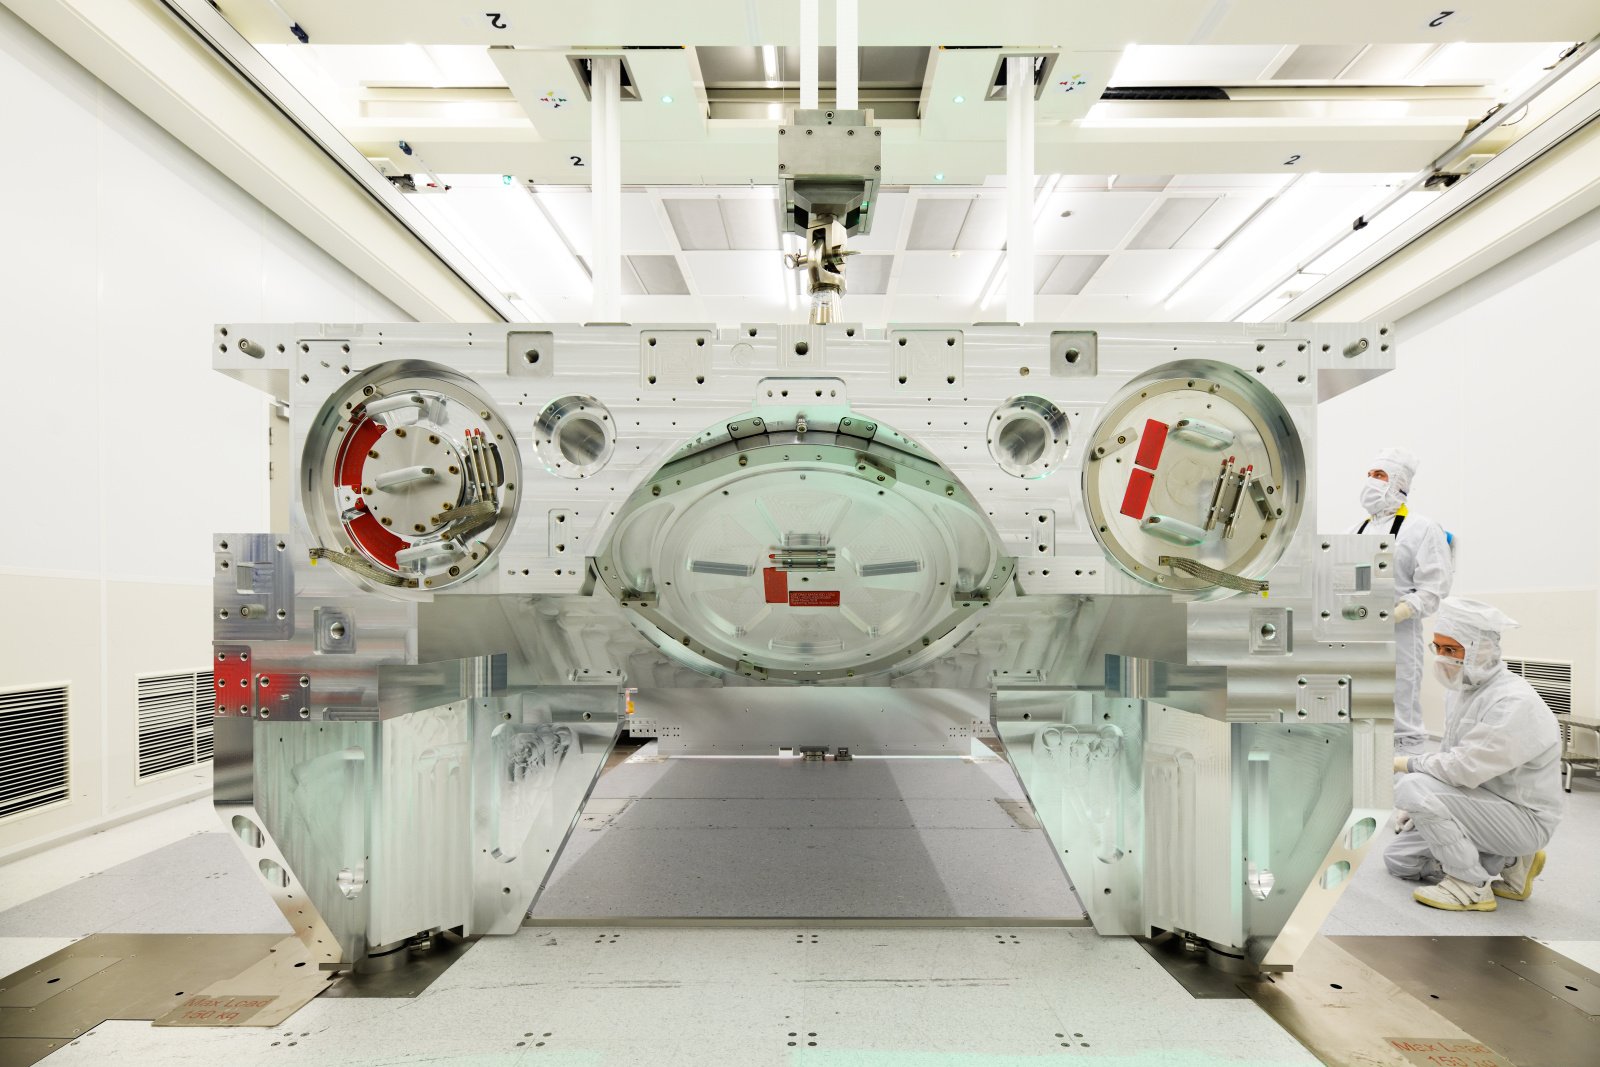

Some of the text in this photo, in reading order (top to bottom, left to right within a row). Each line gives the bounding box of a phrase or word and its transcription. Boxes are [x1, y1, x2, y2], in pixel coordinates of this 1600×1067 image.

[485, 13, 507, 29] 2
[1428, 11, 1455, 28] 2
[570, 156, 585, 166] 2
[1283, 155, 1301, 165] 2
[183, 998, 223, 1007] Max
